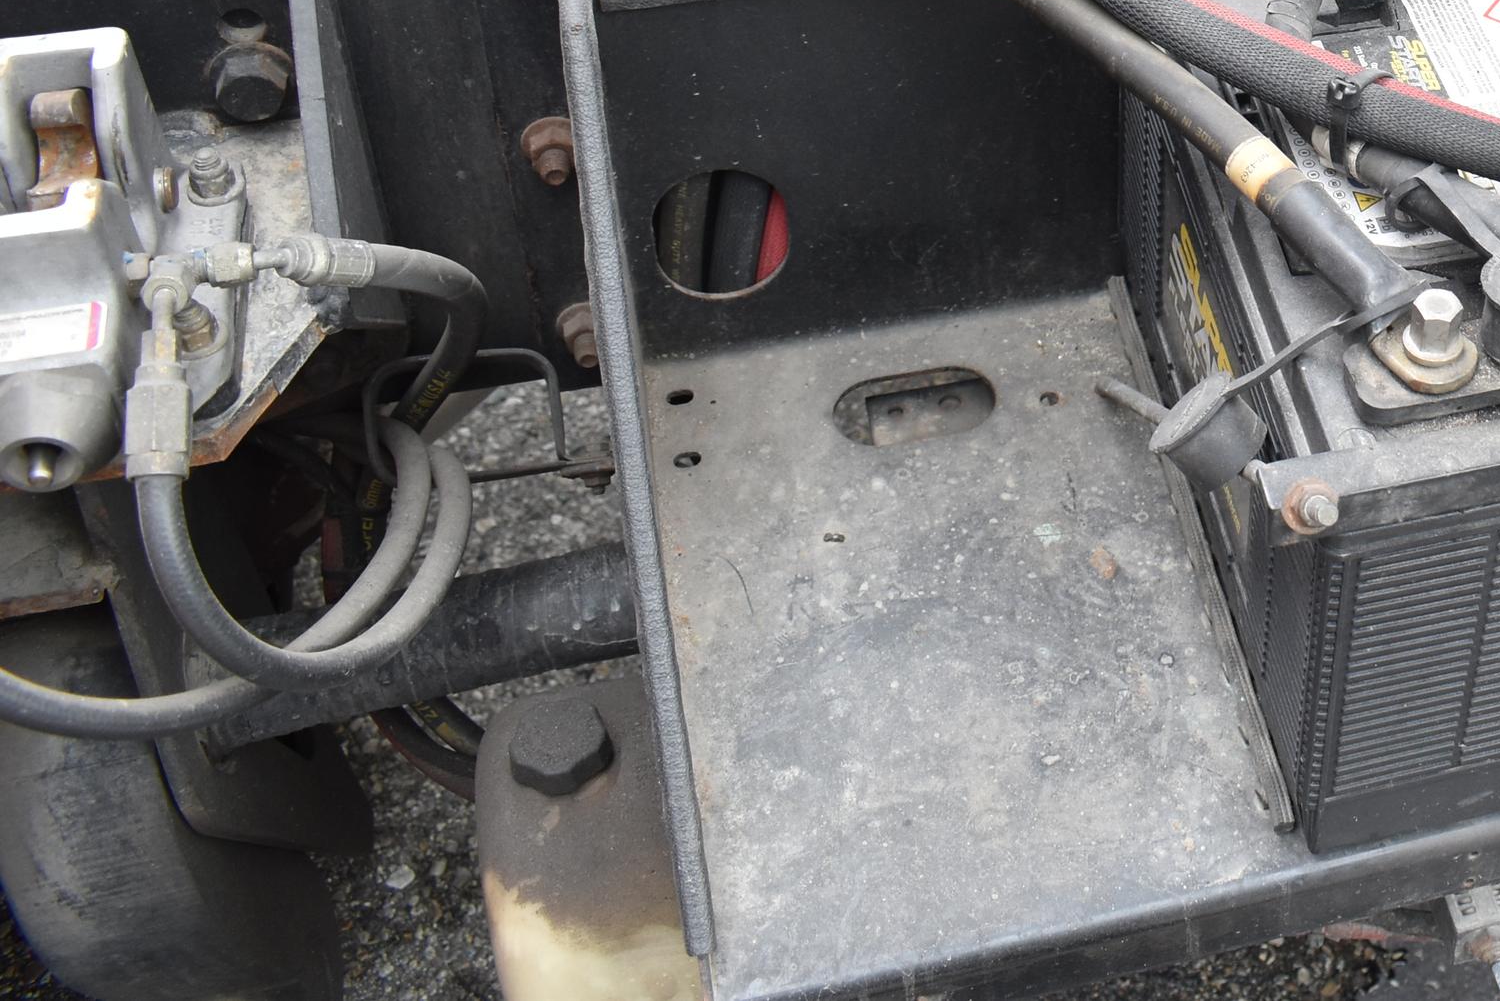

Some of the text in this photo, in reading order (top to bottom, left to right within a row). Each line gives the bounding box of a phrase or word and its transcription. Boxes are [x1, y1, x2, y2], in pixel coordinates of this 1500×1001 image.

[1406, 37, 1442, 91] SUPER
[1181, 116, 1193, 128] IN
[1194, 126, 1221, 153] MADE
[1363, 218, 1379, 235] 12V
[1175, 222, 1236, 379] SUPE
